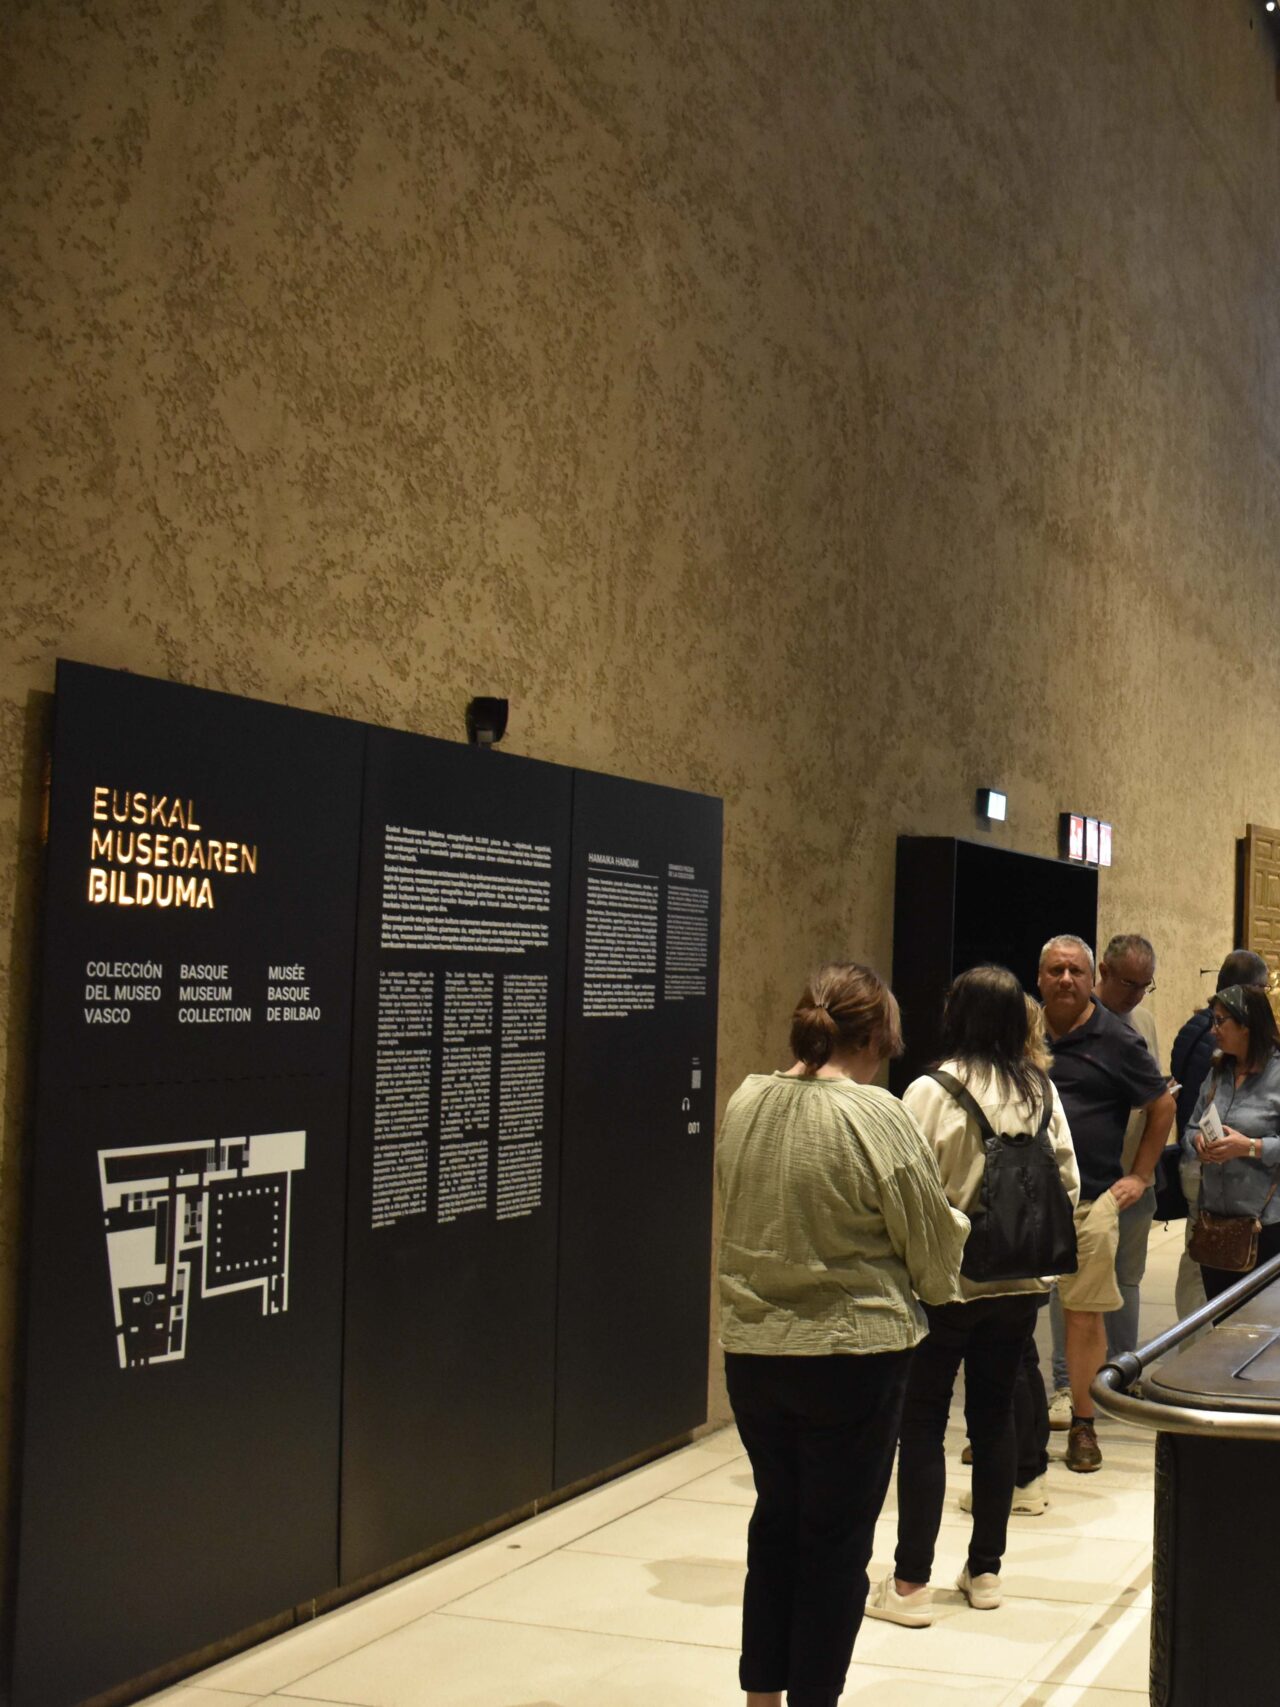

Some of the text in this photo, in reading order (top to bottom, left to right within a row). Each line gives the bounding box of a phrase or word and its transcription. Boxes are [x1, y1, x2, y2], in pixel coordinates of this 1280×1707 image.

[92, 786, 201, 832] EUSKAL
[90, 827, 258, 875] MUSEOAREN
[88, 867, 215, 910] BILDUMA
[86, 960, 163, 979] COLECCIÓN
[180, 964, 229, 980] BASQUE
[268, 963, 305, 980] MUSÉE
[85, 985, 161, 1001] DEL MUSEO
[179, 986, 233, 1001] MUSEUM
[267, 986, 311, 1002] BASQUE
[84, 1007, 131, 1024] VASCO
[178, 1007, 252, 1023] COLLECTION
[267, 1006, 321, 1022] DE BILBAO
[687, 1121, 700, 1135] 001
